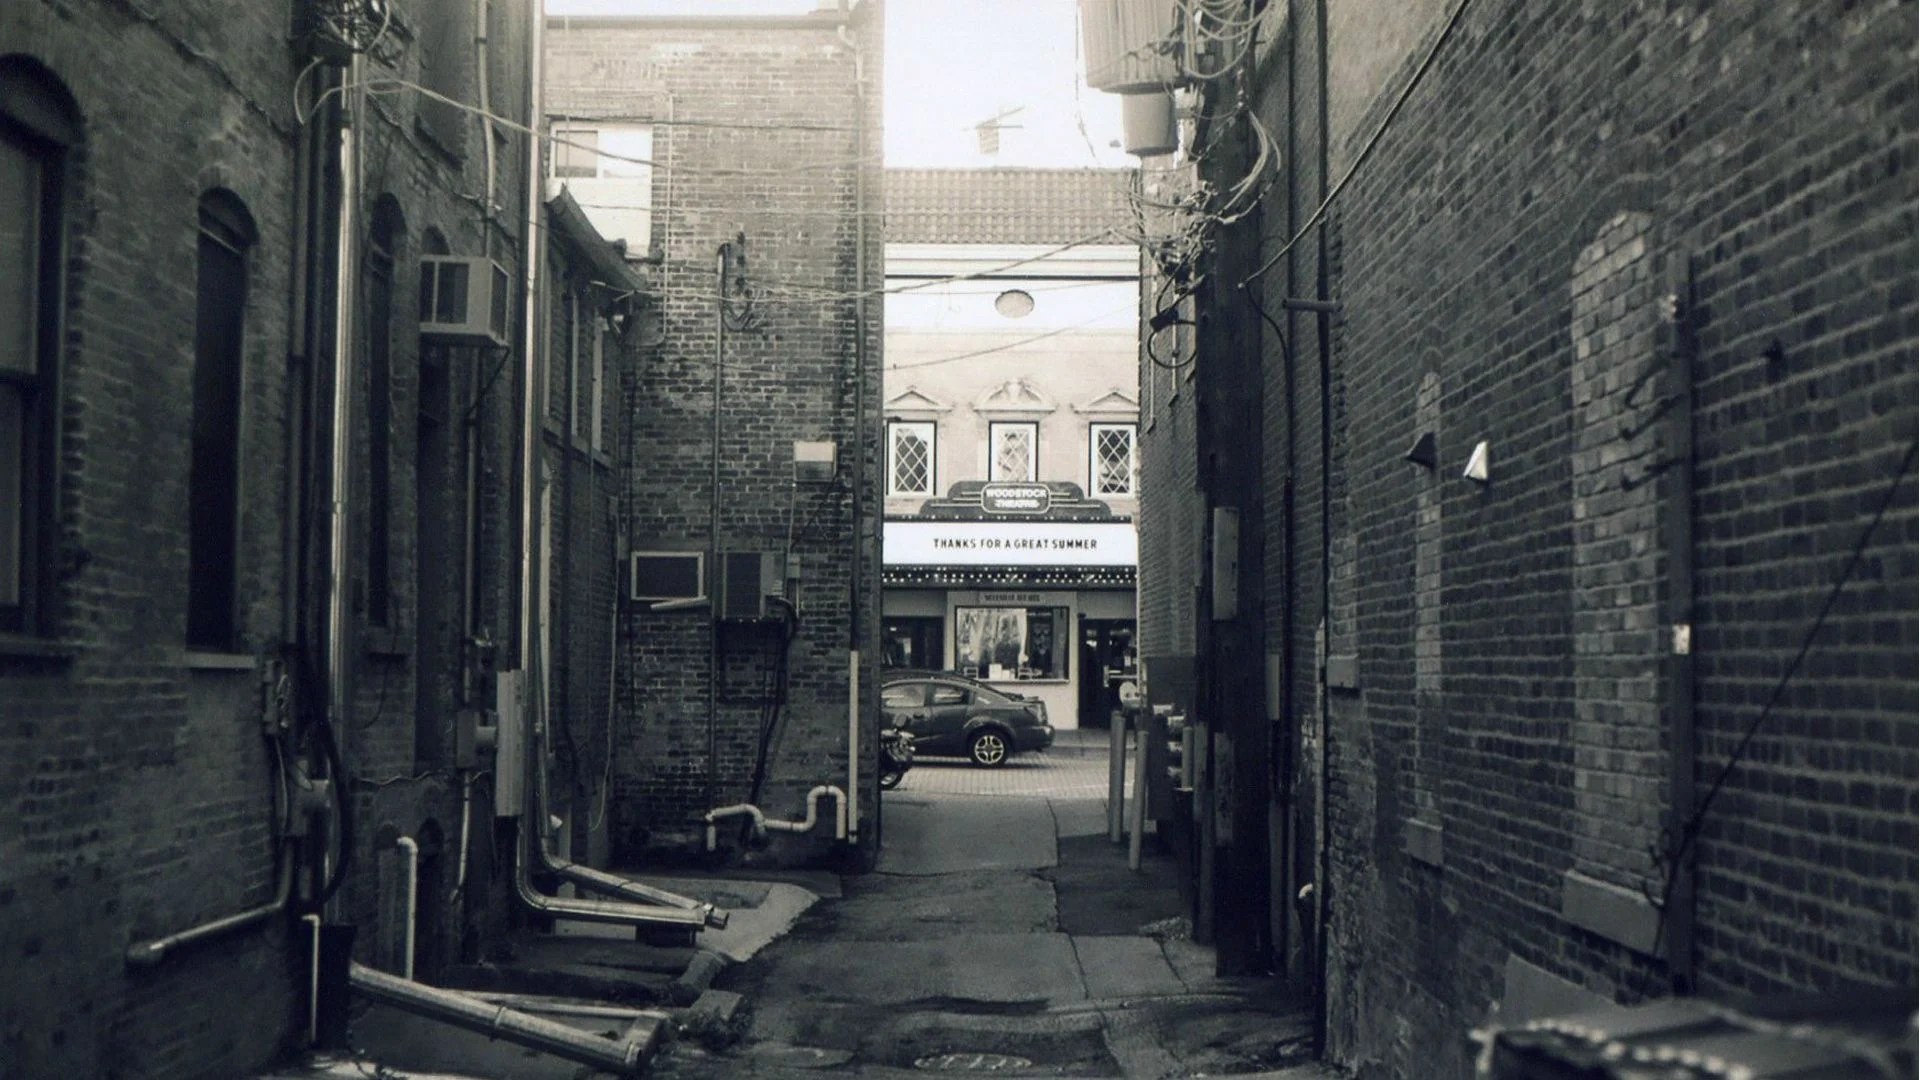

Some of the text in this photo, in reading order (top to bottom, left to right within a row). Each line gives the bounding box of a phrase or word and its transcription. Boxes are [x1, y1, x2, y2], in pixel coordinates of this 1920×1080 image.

[986, 488, 1047, 498] WOODSTOCK
[933, 538, 1098, 549] THANKS FOR A GREAT SUMMER
